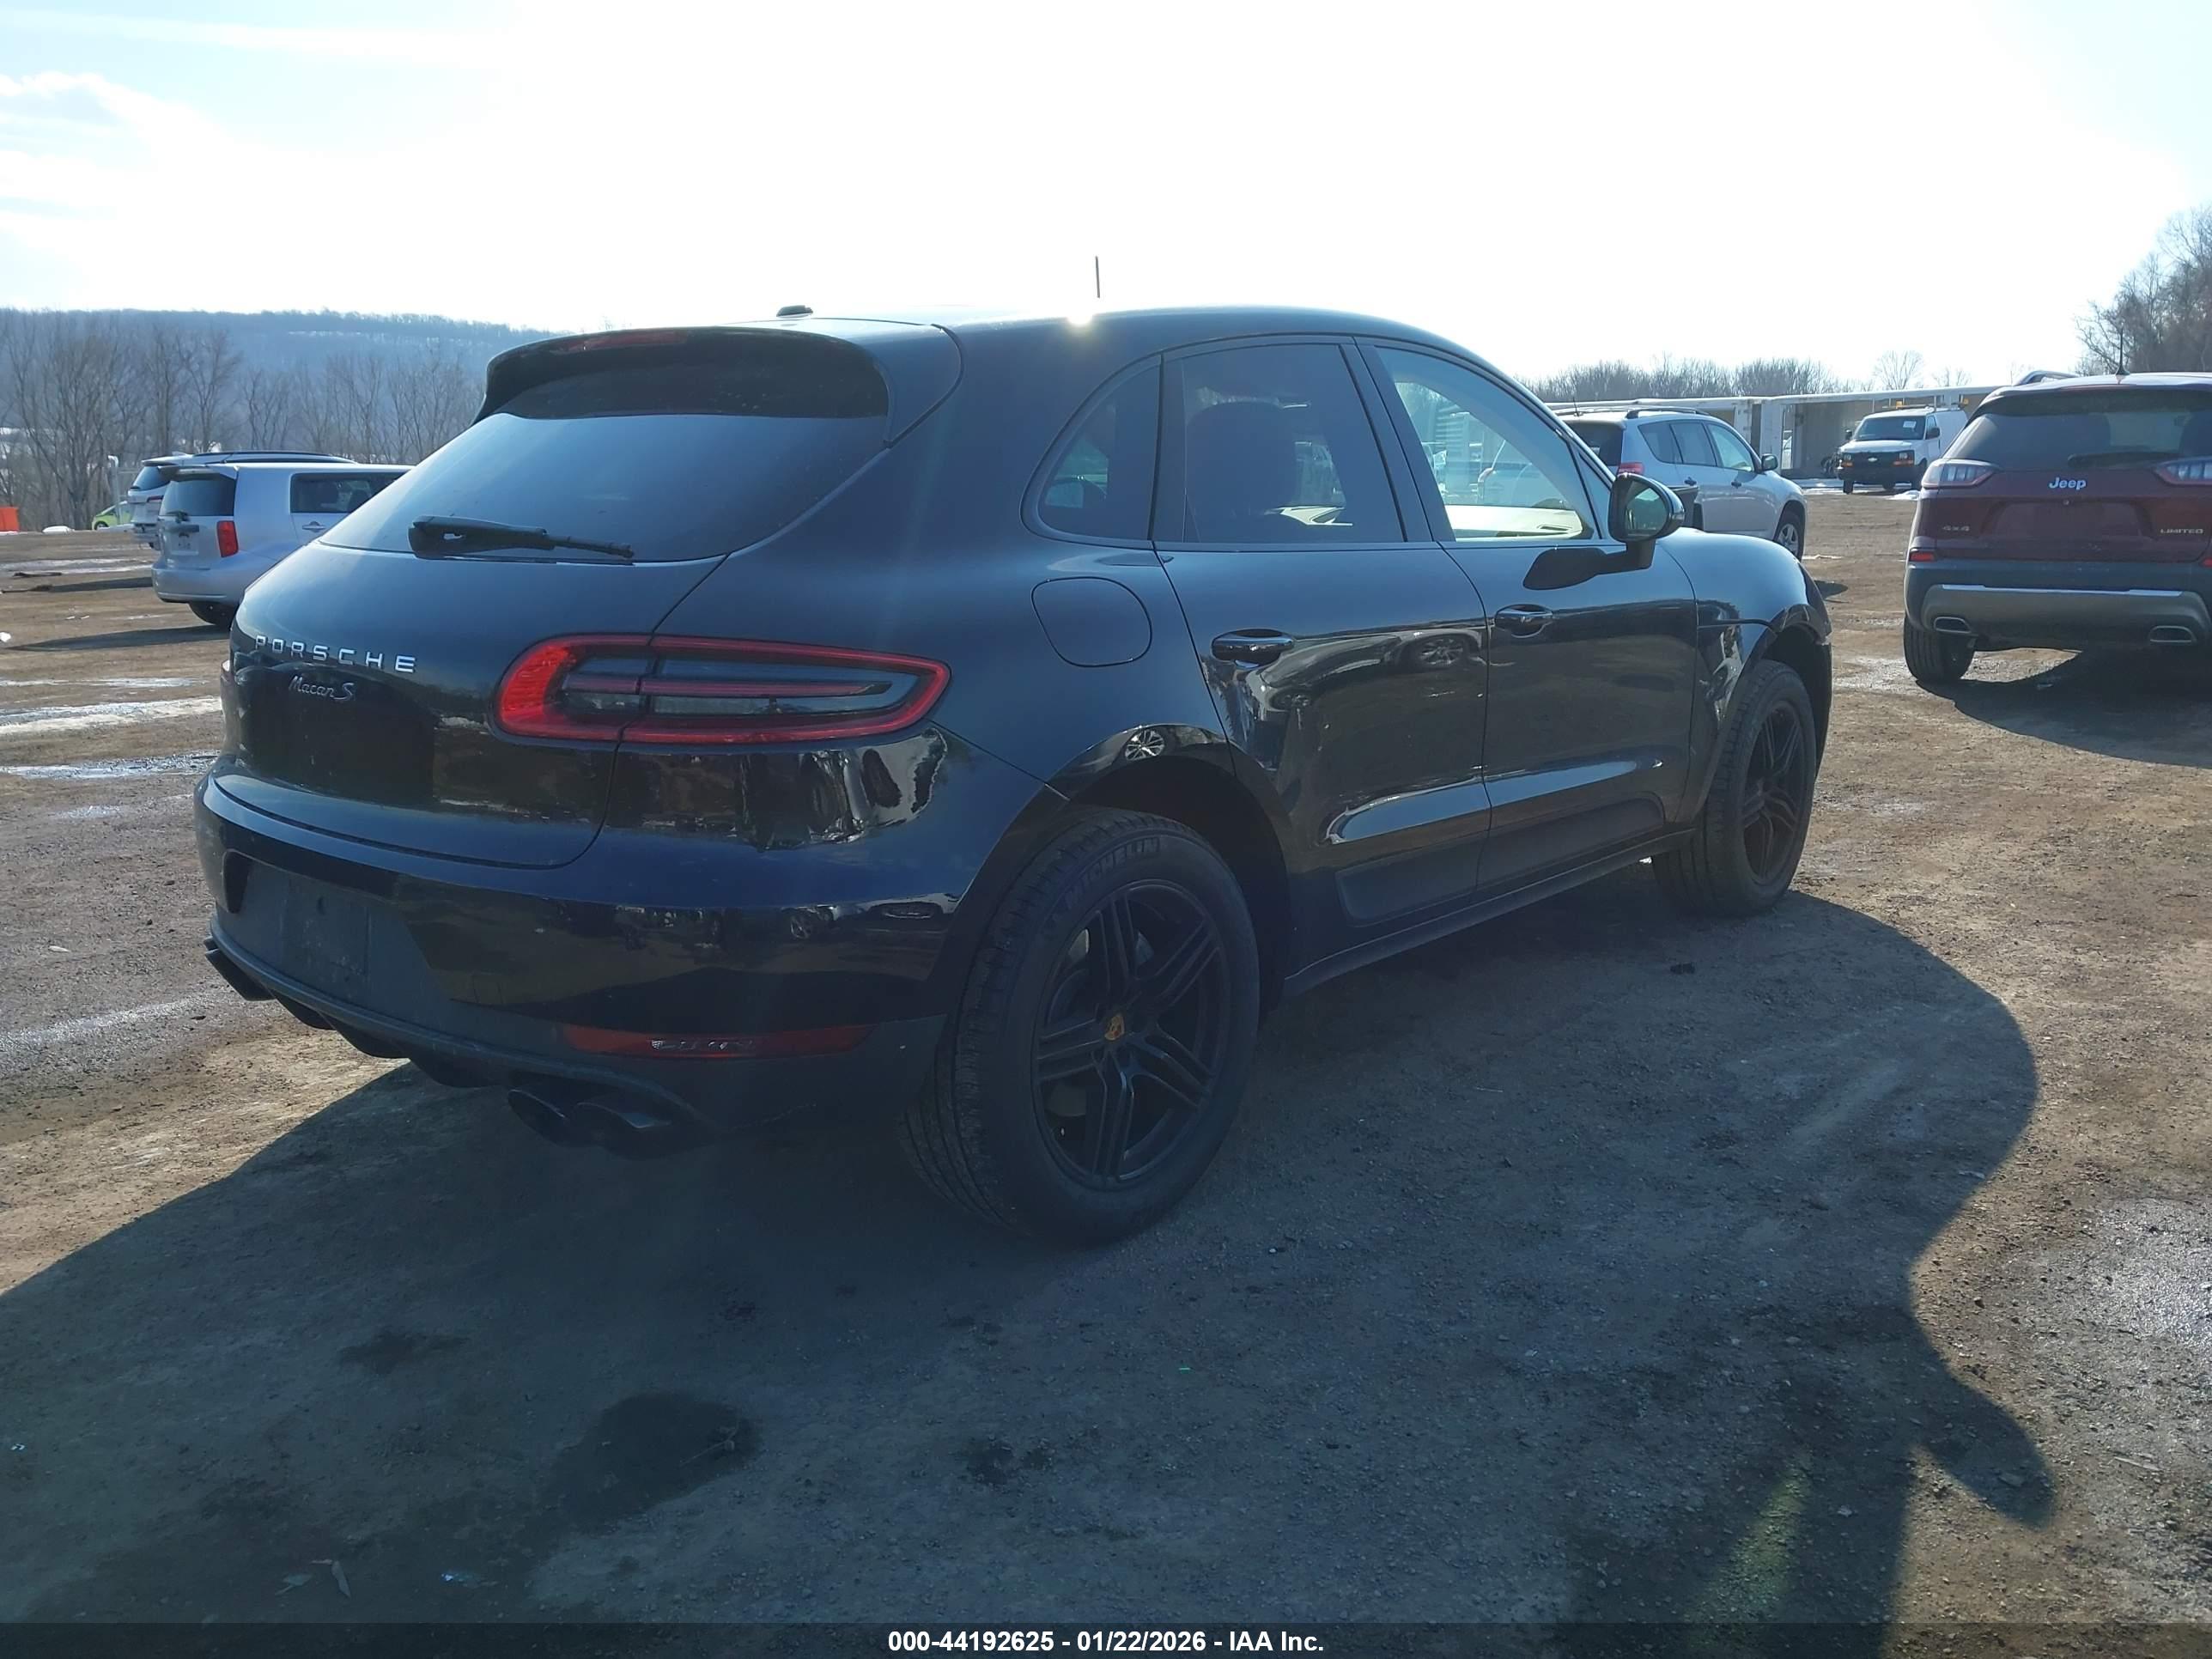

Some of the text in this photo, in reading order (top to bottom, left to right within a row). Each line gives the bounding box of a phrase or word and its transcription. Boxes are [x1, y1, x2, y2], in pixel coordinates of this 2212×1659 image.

[2049, 477, 2087, 490] Jeep
[255, 635, 416, 673] PORSCHE
[289, 675, 354, 699] Macan S
